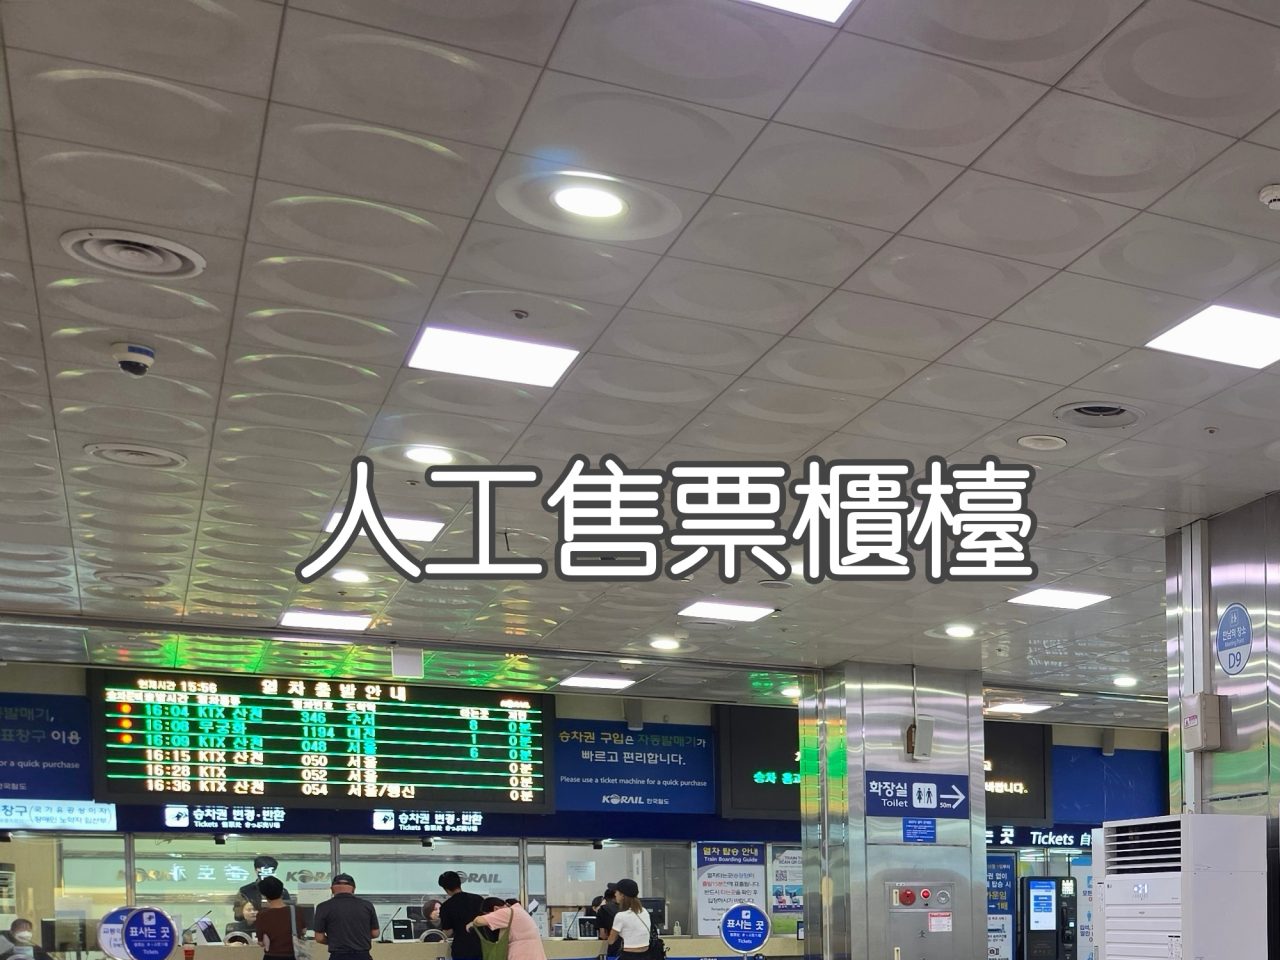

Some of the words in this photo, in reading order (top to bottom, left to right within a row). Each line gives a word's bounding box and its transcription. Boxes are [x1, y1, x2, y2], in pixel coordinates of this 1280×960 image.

[1222, 629, 1236, 641] 만남의
[1237, 626, 1247, 637] 장소
[1228, 651, 1242, 669] D9
[145, 704, 189, 718] 16:04
[198, 705, 225, 719] KTX
[300, 712, 326, 724] 346
[347, 712, 375, 726] 수서
[199, 720, 247, 734] 무궁화
[302, 726, 335, 738] 1194
[51, 730, 81, 745] 이용
[198, 736, 226, 748] KTX
[559, 731, 596, 744] 승차권
[601, 732, 634, 745] 구입은
[637, 734, 707, 748] 자동발매기가
[146, 750, 190, 762] 16:15
[198, 751, 226, 763] KTX
[347, 740, 377, 755] 서울
[470, 747, 479, 759] 6
[18, 760, 40, 769] quick
[42, 760, 80, 770] purchase
[301, 755, 328, 767] 050
[347, 755, 378, 769] 서울
[581, 750, 619, 763] 빠르고
[623, 751, 686, 766] 편리합니다.
[146, 764, 190, 777] 16:28
[198, 766, 226, 778] KTX
[301, 770, 328, 781] 052
[348, 769, 378, 783] 서울
[147, 780, 191, 792] 16:36
[199, 780, 227, 793] KTX
[619, 777, 646, 785] machine
[662, 778, 679, 787] quick
[680, 779, 708, 788] purchase
[869, 780, 908, 798] 화장실
[302, 784, 328, 796] 054
[602, 794, 645, 805] KORAIL
[881, 798, 908, 808] Toilet
[940, 801, 952, 809] 50m
[2, 805, 28, 816] 창구
[193, 808, 228, 821] 승차권
[232, 808, 286, 822] 변경·반환
[398, 812, 430, 824] 승차권
[434, 813, 483, 826] 변경·반환
[1000, 826, 1014, 844] 곳
[1030, 831, 1074, 845] Tickets
[1080, 832, 1092, 846] 自
[704, 847, 720, 856] 열차
[723, 848, 739, 856] 탑승
[742, 848, 758, 856] 안내
[457, 871, 502, 884] ORAIL
[130, 926, 156, 938] 표사는
[160, 926, 170, 938] 곳
[727, 920, 752, 930] 표사는
[756, 921, 764, 930] 곳
